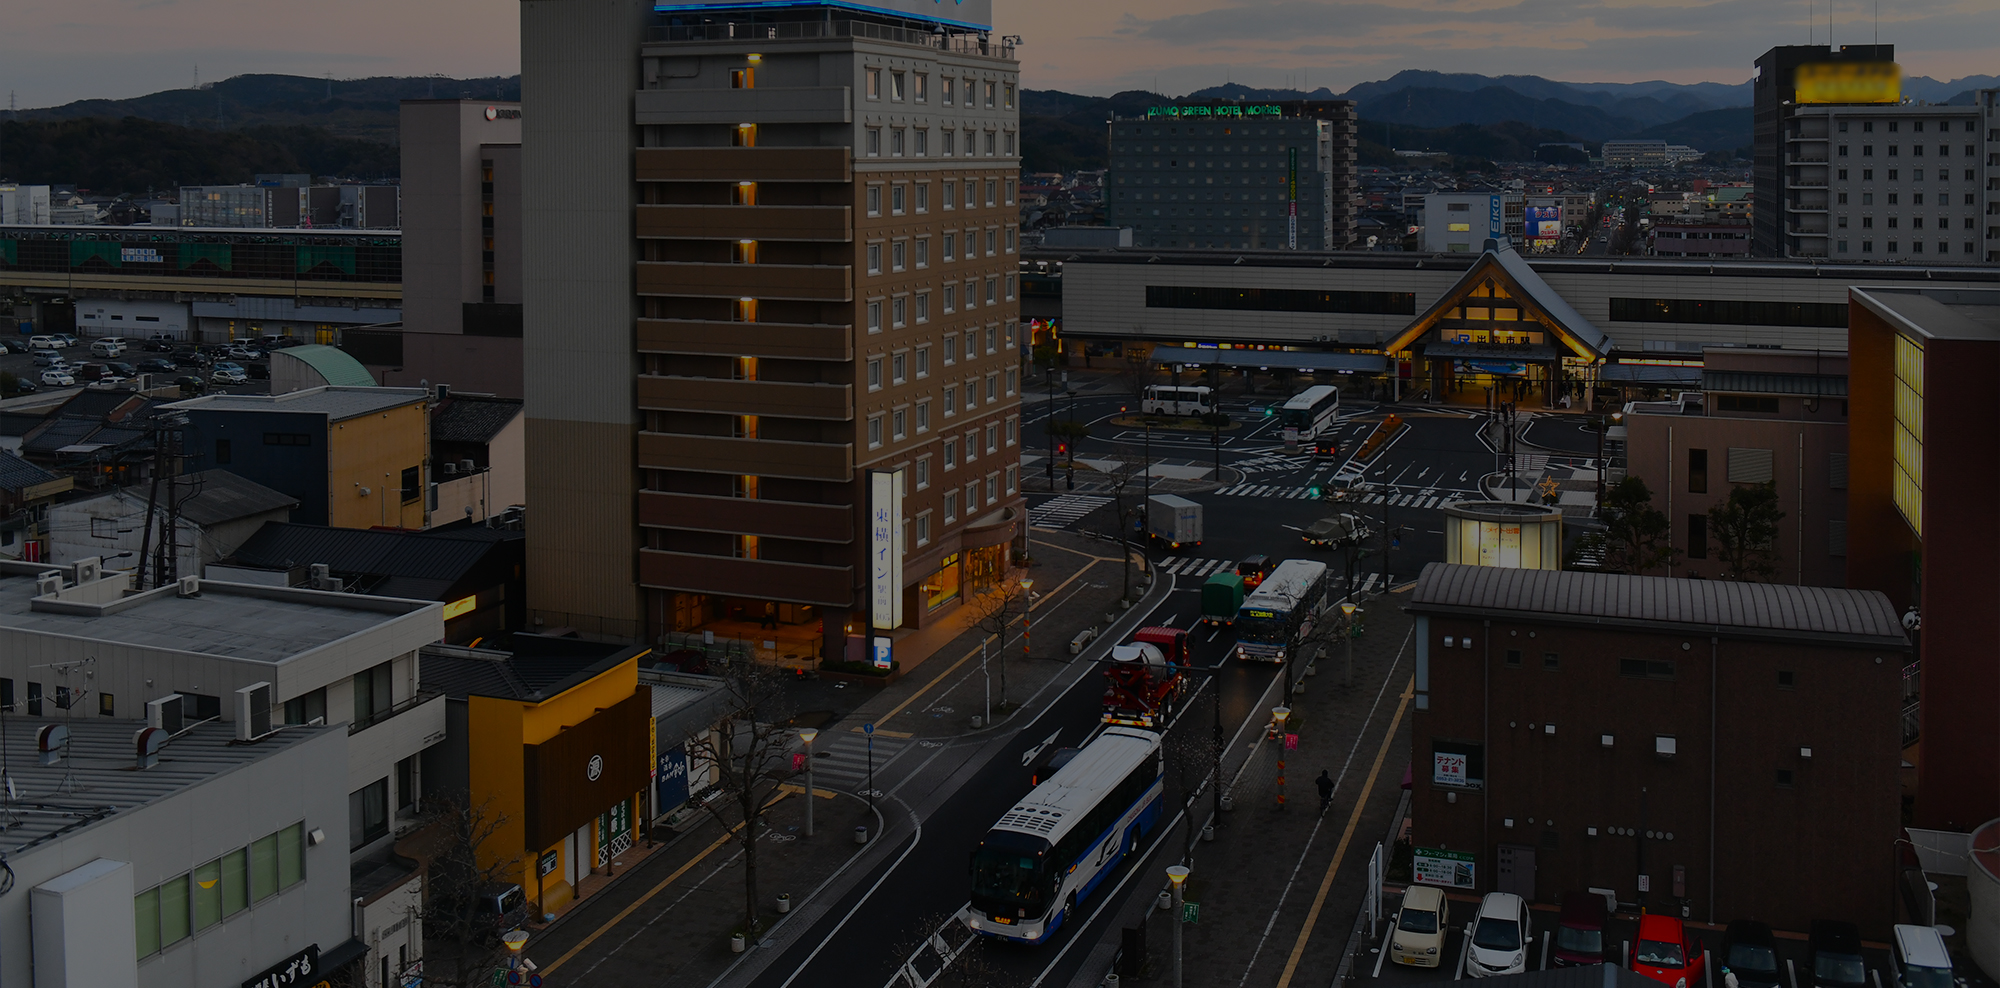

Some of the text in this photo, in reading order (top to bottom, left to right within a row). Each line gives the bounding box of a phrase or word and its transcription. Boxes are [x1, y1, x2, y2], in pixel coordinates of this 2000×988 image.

[1147, 104, 1281, 116] IZUMO GREEN HOTEL MORRIS
[1490, 198, 1499, 233] EIKO
[1450, 334, 1471, 345] JR
[877, 646, 889, 661] P
[1437, 756, 1464, 766] テナント
[1442, 765, 1459, 773] 募集
